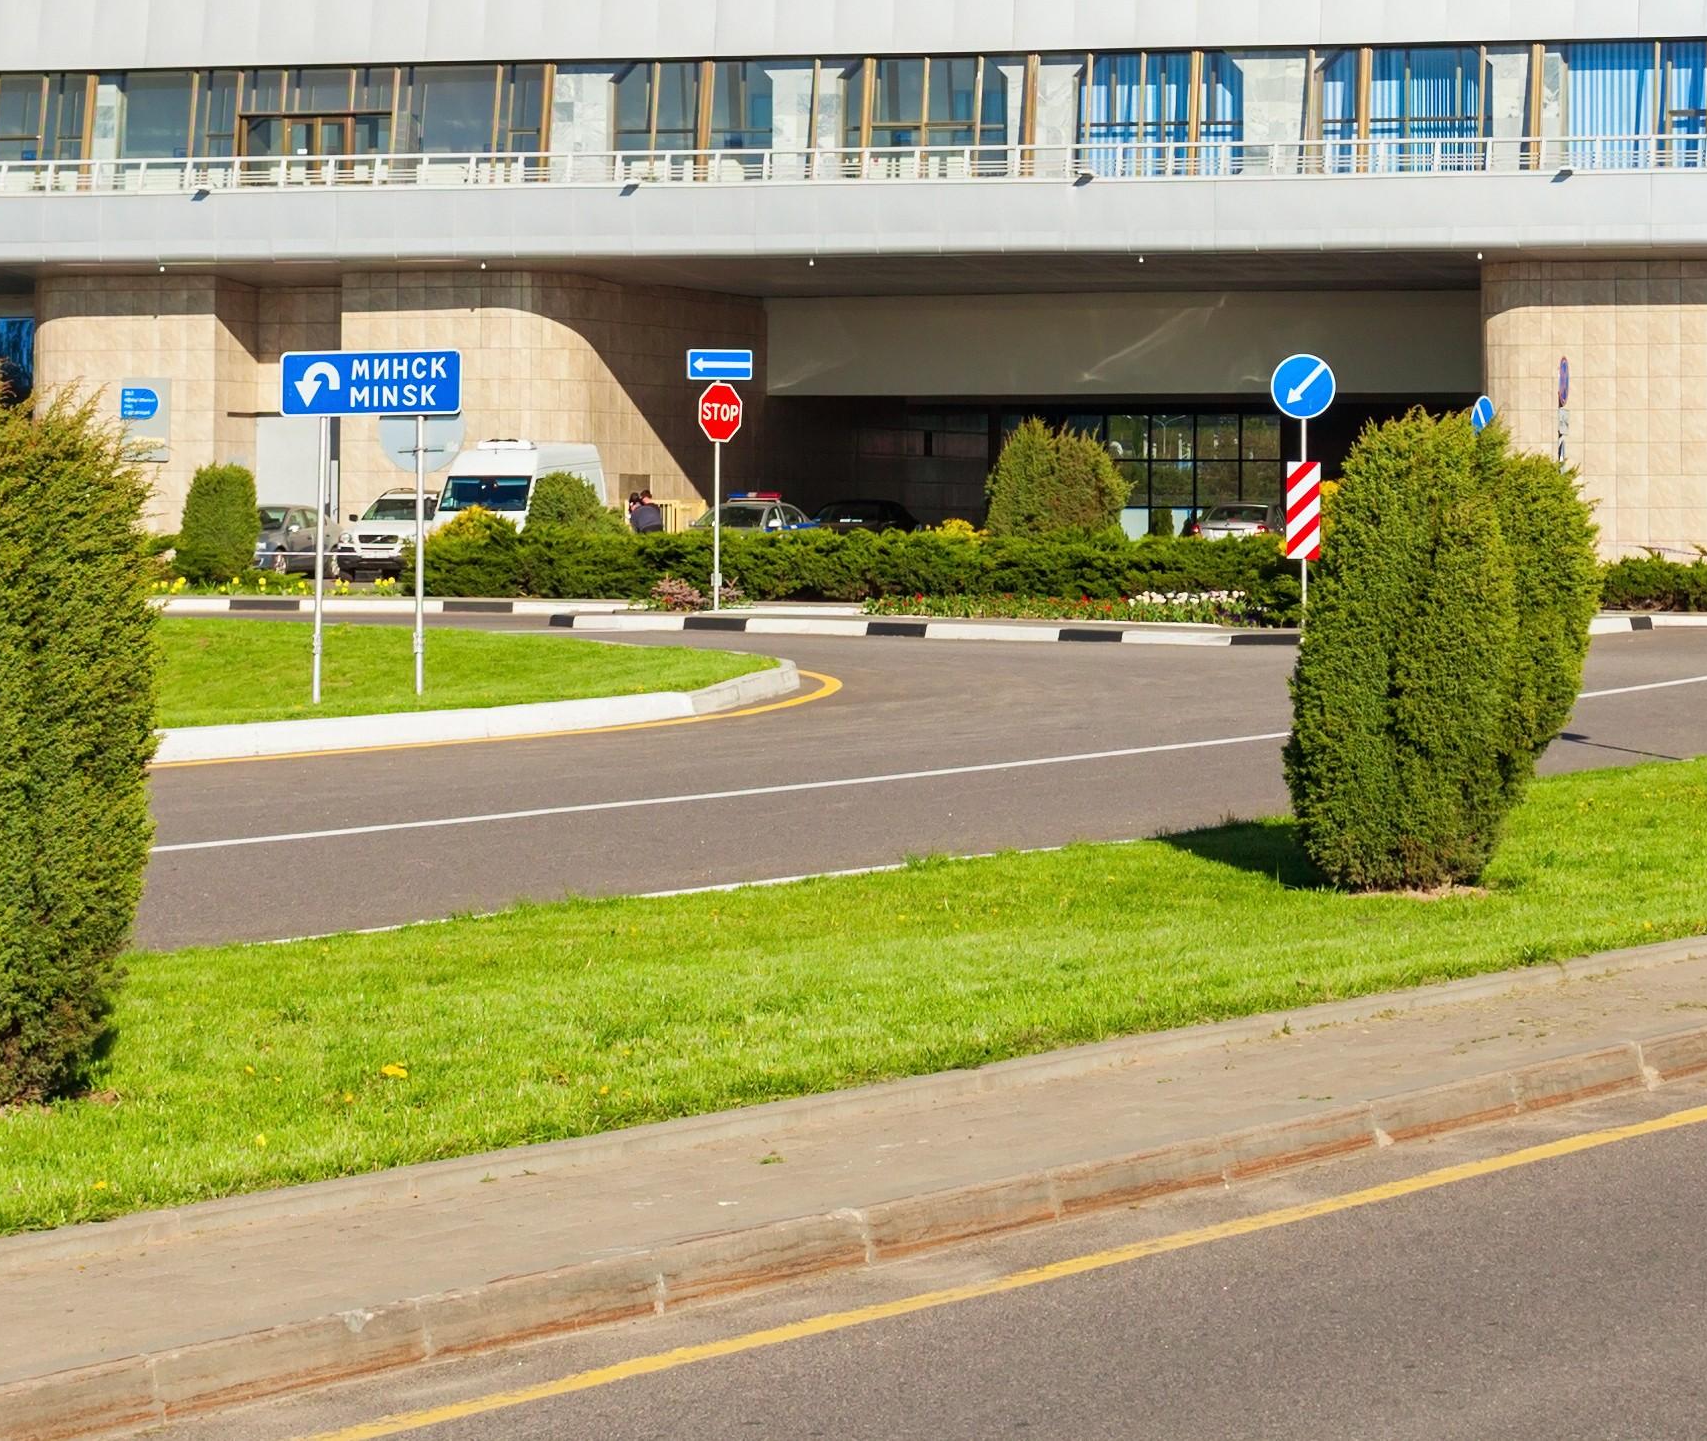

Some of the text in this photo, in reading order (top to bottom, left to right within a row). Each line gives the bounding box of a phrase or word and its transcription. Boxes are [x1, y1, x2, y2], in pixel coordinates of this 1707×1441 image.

[351, 357, 447, 380] МИНСК
[350, 384, 436, 407] MINSK
[702, 402, 739, 421] STOP
